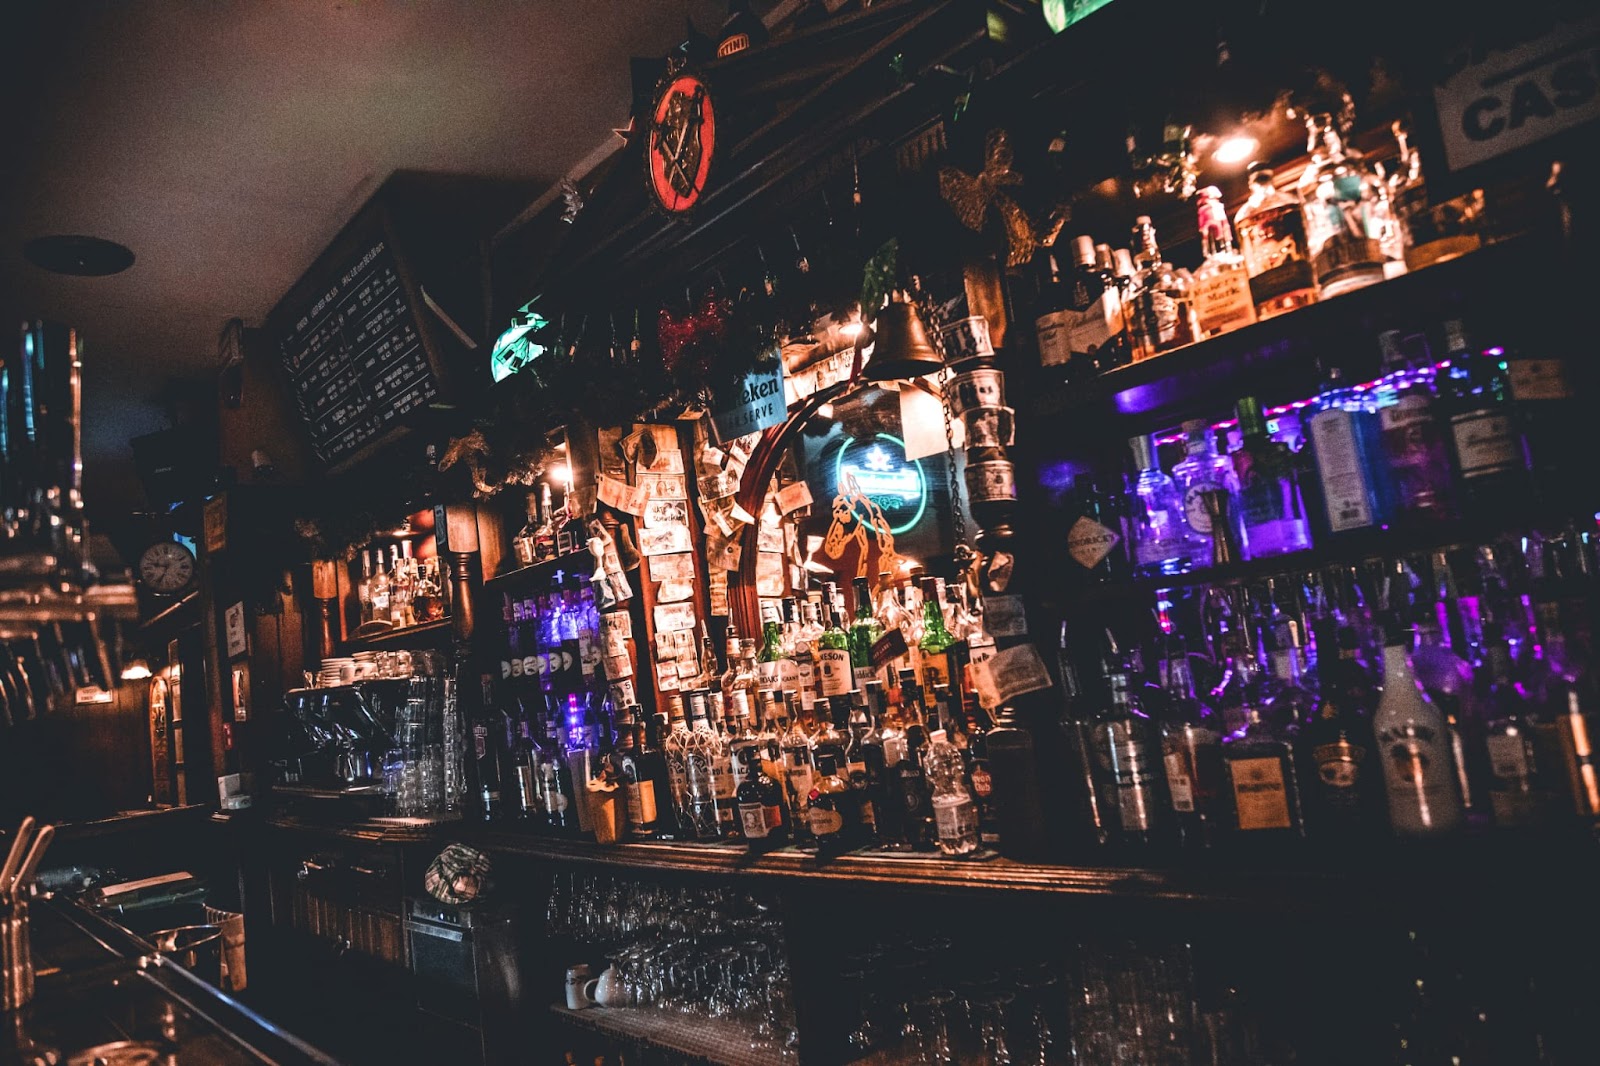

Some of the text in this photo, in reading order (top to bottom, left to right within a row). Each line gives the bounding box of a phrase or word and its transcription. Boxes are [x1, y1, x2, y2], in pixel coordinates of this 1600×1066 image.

[1463, 58, 1600, 141] CAS
[742, 378, 779, 406] eken
[625, 682, 631, 690] 5
